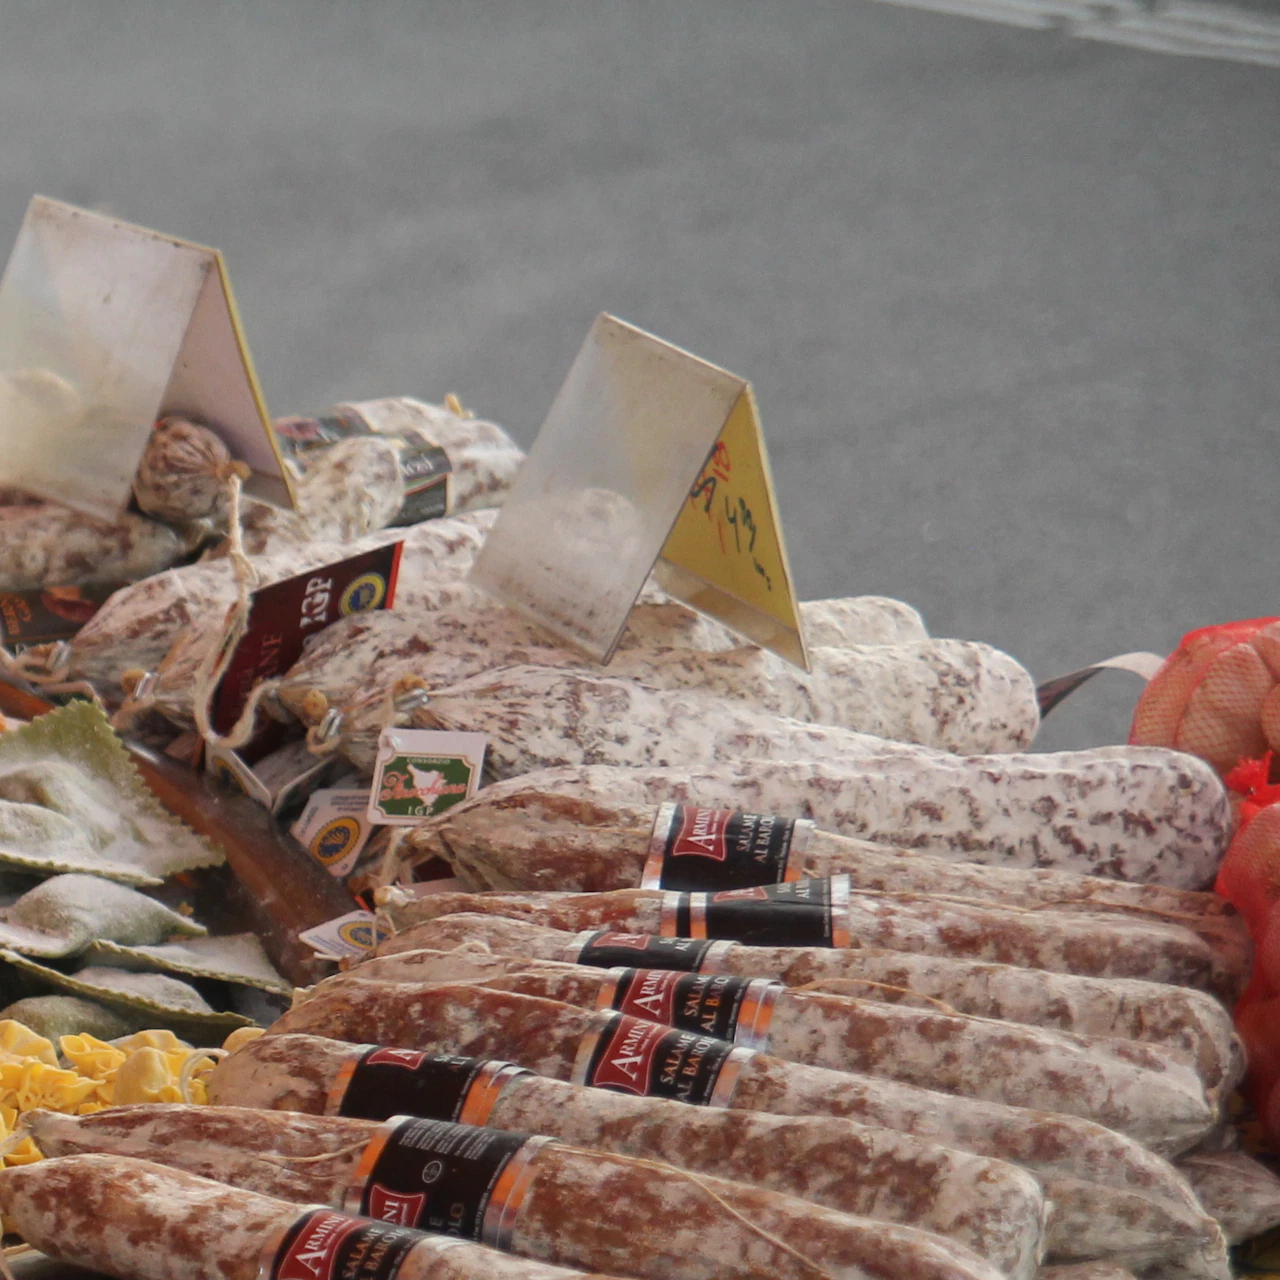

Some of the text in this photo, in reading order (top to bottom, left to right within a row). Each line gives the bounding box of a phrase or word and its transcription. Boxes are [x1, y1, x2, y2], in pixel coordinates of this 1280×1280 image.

[300, 577, 333, 628] IGP
[407, 805, 434, 816] IGP
[754, 845, 768, 864] AL
[699, 1010, 719, 1034] AL
[660, 1033, 697, 1086] SALAME
[676, 1075, 696, 1104] AL
[342, 1227, 386, 1280] SALAME
